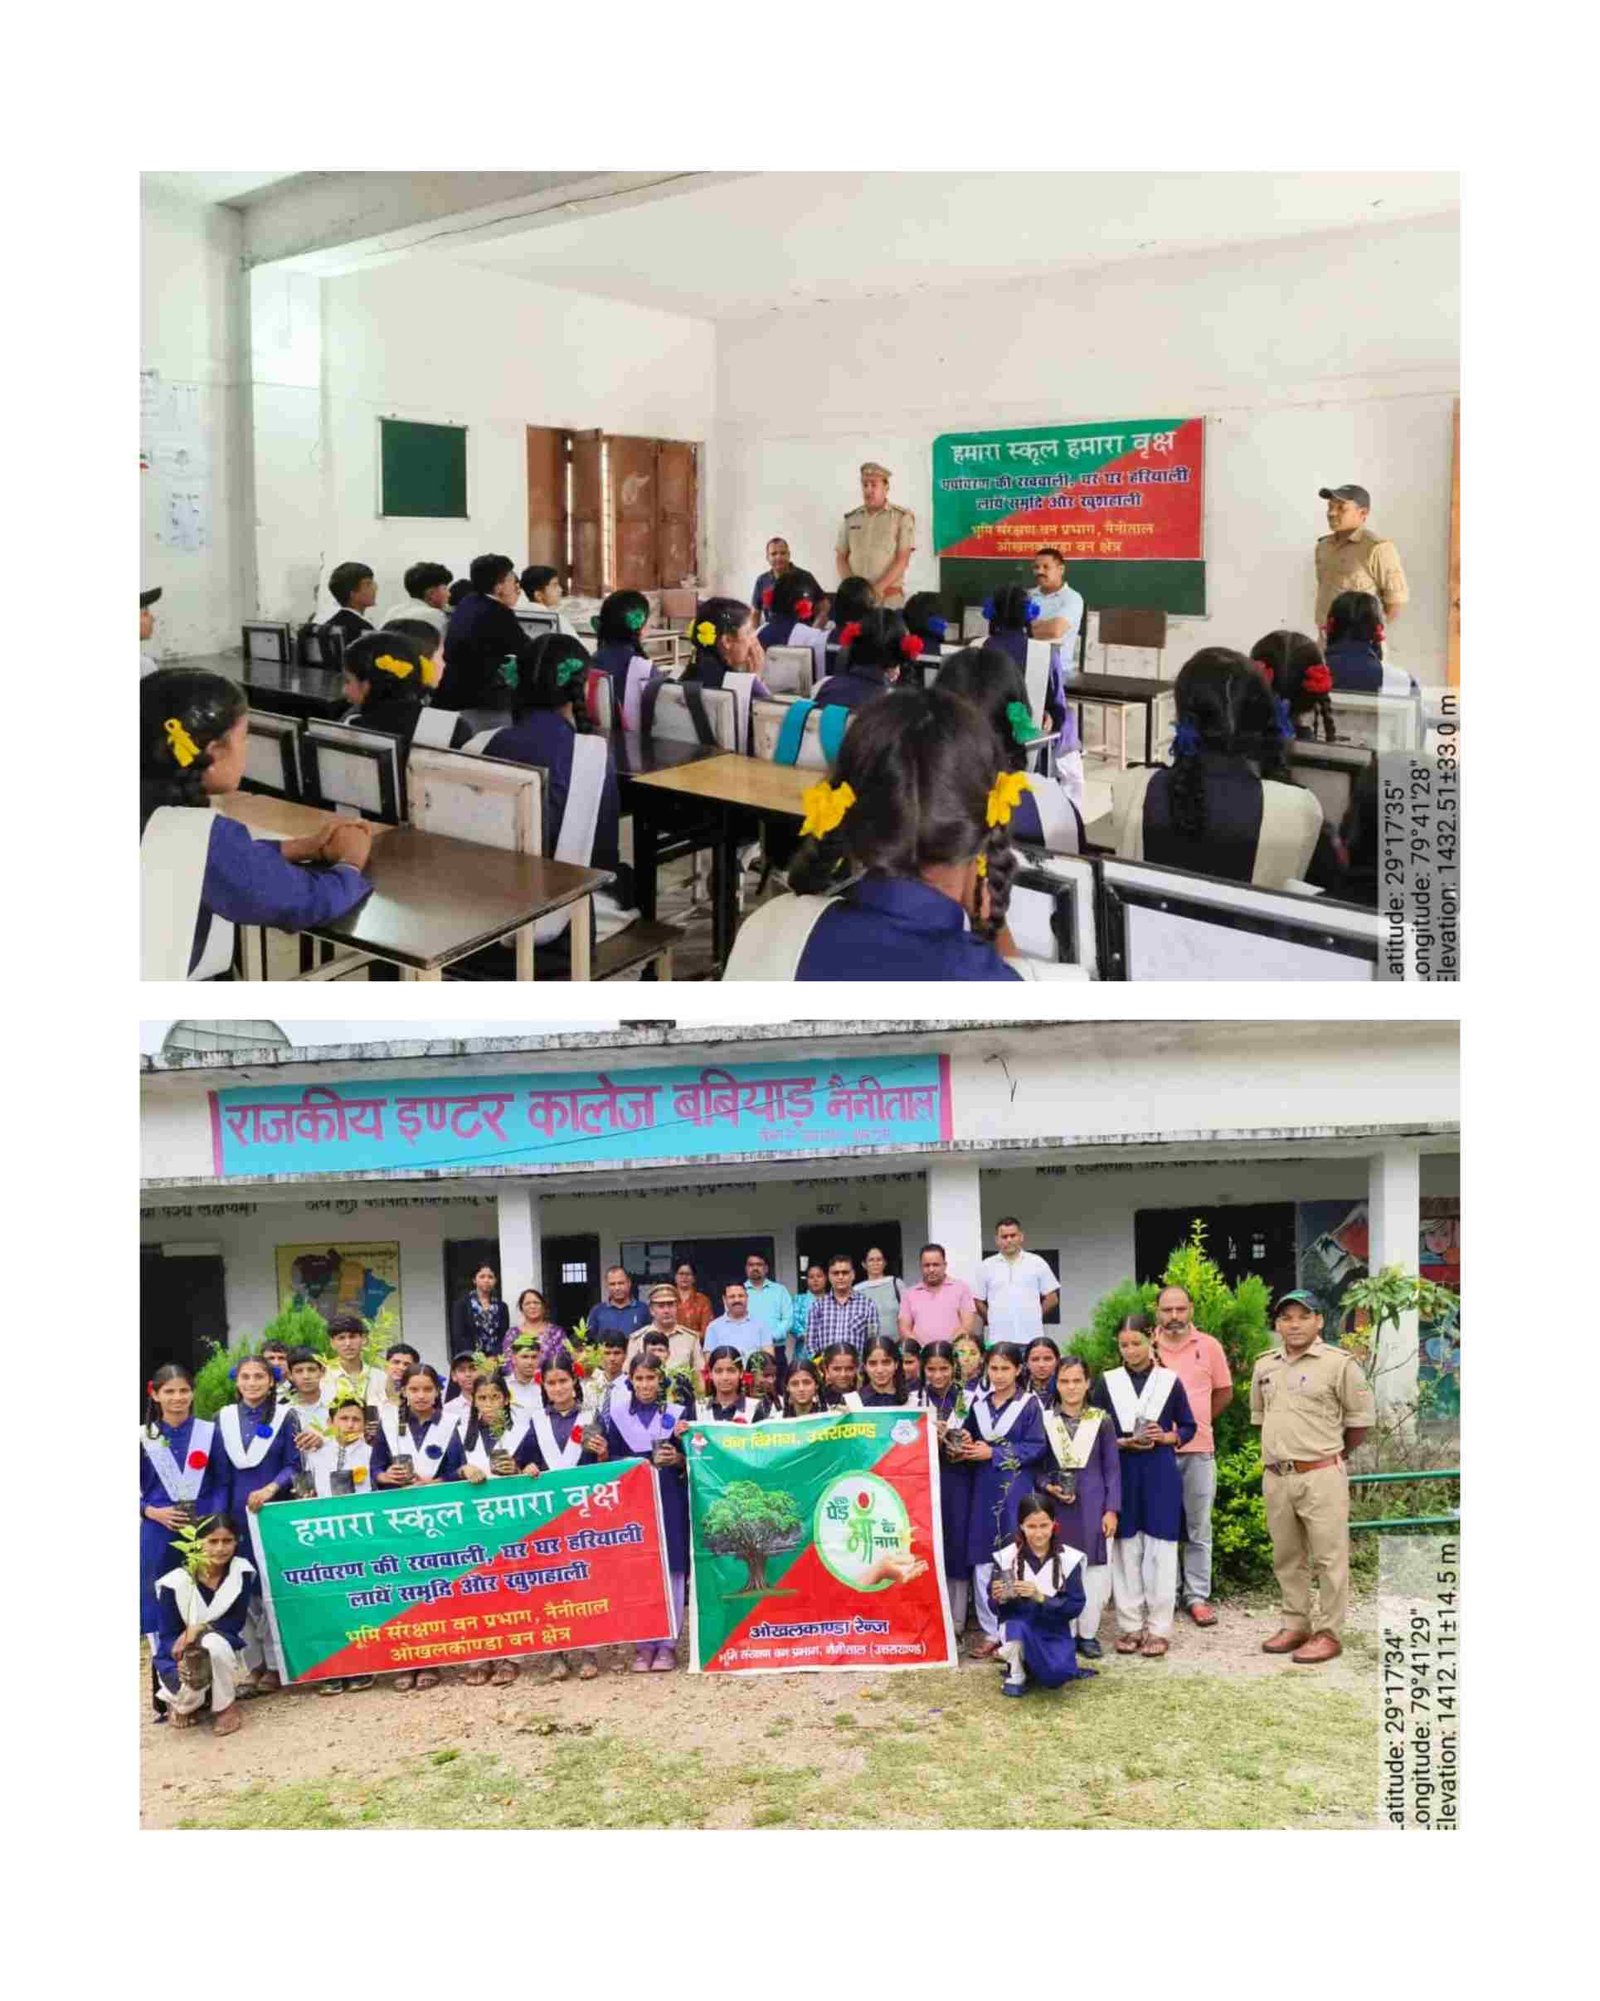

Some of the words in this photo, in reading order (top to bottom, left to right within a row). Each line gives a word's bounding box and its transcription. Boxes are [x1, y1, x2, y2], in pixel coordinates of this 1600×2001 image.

[951, 443, 1000, 465] हमारा
[1006, 438, 1059, 466] स्कूल
[1064, 434, 1124, 459] हमारा
[1131, 430, 1178, 459] वृक्ष
[994, 473, 1012, 489] की
[1127, 465, 1191, 485] हरियाली
[1047, 492, 1075, 509] और
[1037, 525, 1057, 536] वन
[1104, 519, 1155, 535] नैनीताल
[1076, 540, 1095, 552] वन
[225, 1087, 387, 1146] राजकीय
[394, 1093, 514, 1146] इण्टर
[529, 1073, 662, 1136] कालेज
[672, 1068, 816, 1128] बबियाड़
[826, 1072, 939, 1123] नैनीताल
[807, 1423, 876, 1443] उत्तराखण्ड
[290, 1512, 374, 1547] हमारा
[383, 1500, 464, 1539] स्कूल
[472, 1490, 555, 1526] हमारा
[562, 1480, 621, 1518] वृक्ष
[283, 1559, 365, 1585] पर्यावरण
[371, 1554, 399, 1575] की
[406, 1543, 494, 1571] रखवाली,
[501, 1541, 527, 1560] घर
[534, 1536, 561, 1554] घर
[567, 1522, 645, 1550] हरियाली
[873, 1536, 899, 1549] नाम
[346, 1584, 394, 1608] लायें
[460, 1574, 499, 1595] और
[503, 1560, 591, 1593] खुशहाली
[345, 1624, 381, 1649] भूमि
[385, 1620, 447, 1640] संरक्षण
[450, 1616, 478, 1632] वन
[543, 1598, 610, 1620] नैनीताल
[508, 1631, 535, 1647] वन
[542, 1623, 571, 1645] क्षेत्र
[750, 1619, 850, 1640] ओखलकाण्डा
[853, 1615, 890, 1635] रेन्ज
